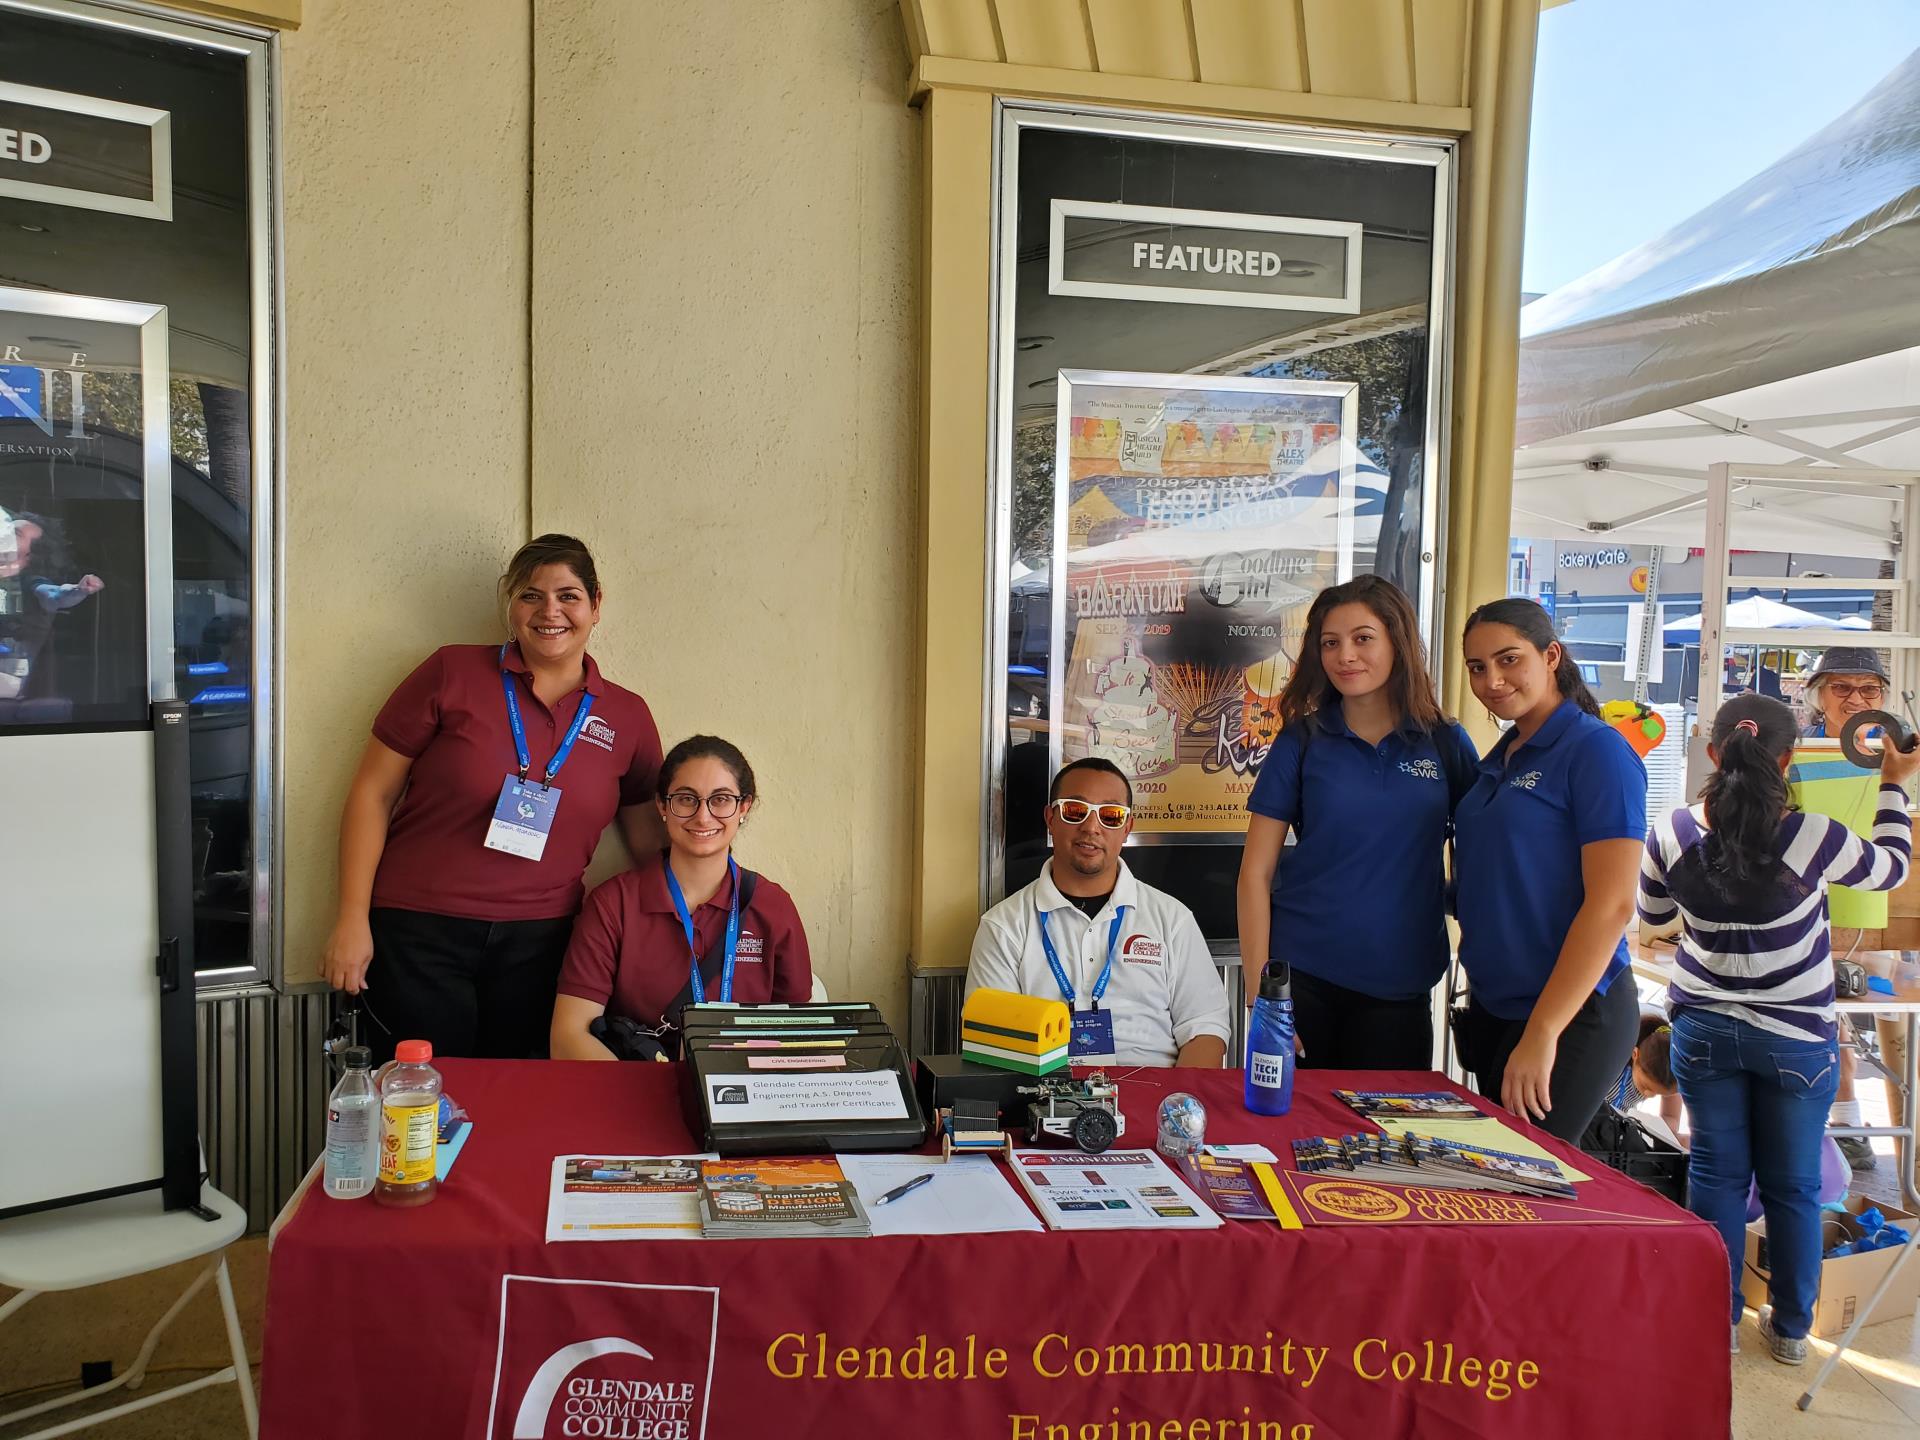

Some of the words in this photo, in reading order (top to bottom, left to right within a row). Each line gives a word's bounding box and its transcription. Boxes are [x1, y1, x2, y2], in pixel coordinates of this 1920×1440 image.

[1133, 242, 1281, 277] FEATURED
[1277, 449, 1305, 459] ALEX
[1560, 553, 1595, 569] Bakery
[1076, 570, 1185, 617] BARNUM
[1143, 624, 1172, 635] 2019
[1228, 625, 1258, 637] NOV.
[1260, 626, 1277, 638] 10,
[1136, 783, 1167, 793] 2020
[1224, 783, 1253, 794] MAY
[1133, 950, 1162, 958] COLLEGE
[1254, 1063, 1278, 1075] TECH
[753, 1080, 796, 1088] Glendale
[798, 1080, 853, 1088] Community
[855, 1079, 889, 1087] College
[1253, 1073, 1277, 1084] WEEK
[753, 1091, 811, 1100] Engineering
[833, 1090, 872, 1098] Degrees
[842, 1100, 897, 1108] Certificates
[381, 1154, 397, 1169] LEAF
[1050, 1154, 1148, 1163] ENGINEERING
[765, 1191, 840, 1199] Engineering
[1404, 1188, 1533, 1212] GLENDALE
[767, 1197, 842, 1205] DESIGN
[768, 1202, 845, 1210] Manufacturing
[1417, 1205, 1543, 1221] COLLEGE
[766, 1331, 1007, 1381] Glendale
[1032, 1331, 1330, 1388] Community
[1353, 1337, 1540, 1401] College
[567, 1378, 695, 1403] GLENDALE
[564, 1398, 693, 1421] COMMUNITY
[562, 1415, 690, 1440] COLLEGE
